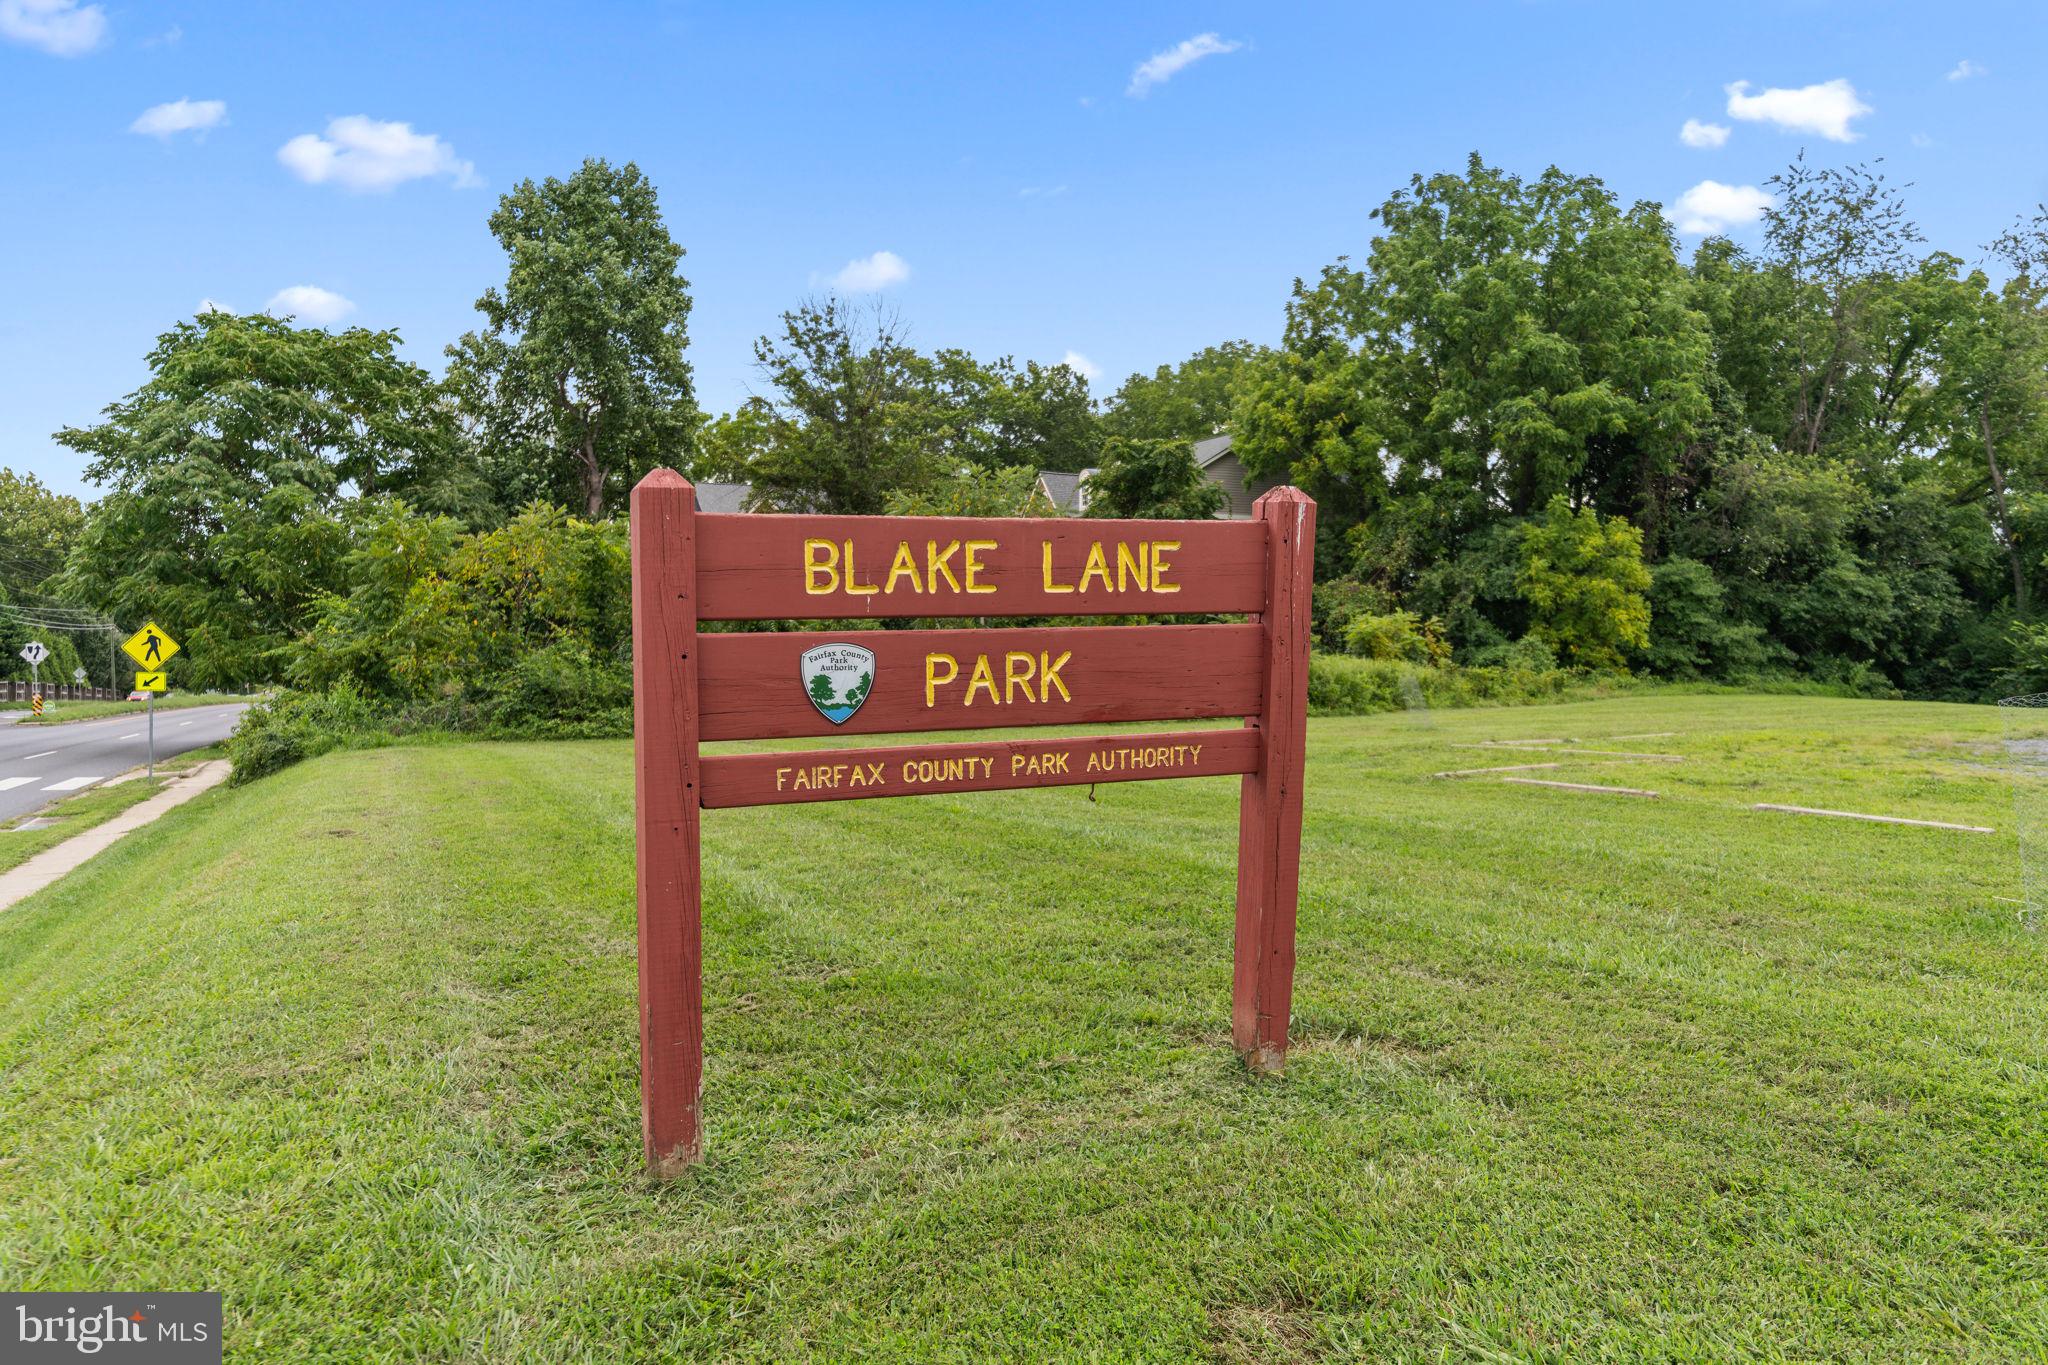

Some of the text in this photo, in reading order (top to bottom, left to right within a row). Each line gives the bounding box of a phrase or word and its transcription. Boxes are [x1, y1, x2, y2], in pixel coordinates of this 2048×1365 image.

[803, 539, 1182, 595] BLAKE LANE
[808, 650, 869, 663] Fairfax County
[820, 664, 858, 672] Authority
[926, 651, 1072, 708] PARK
[776, 744, 1203, 791] FAIRFAX COUNTY PARK AUTHORITY
